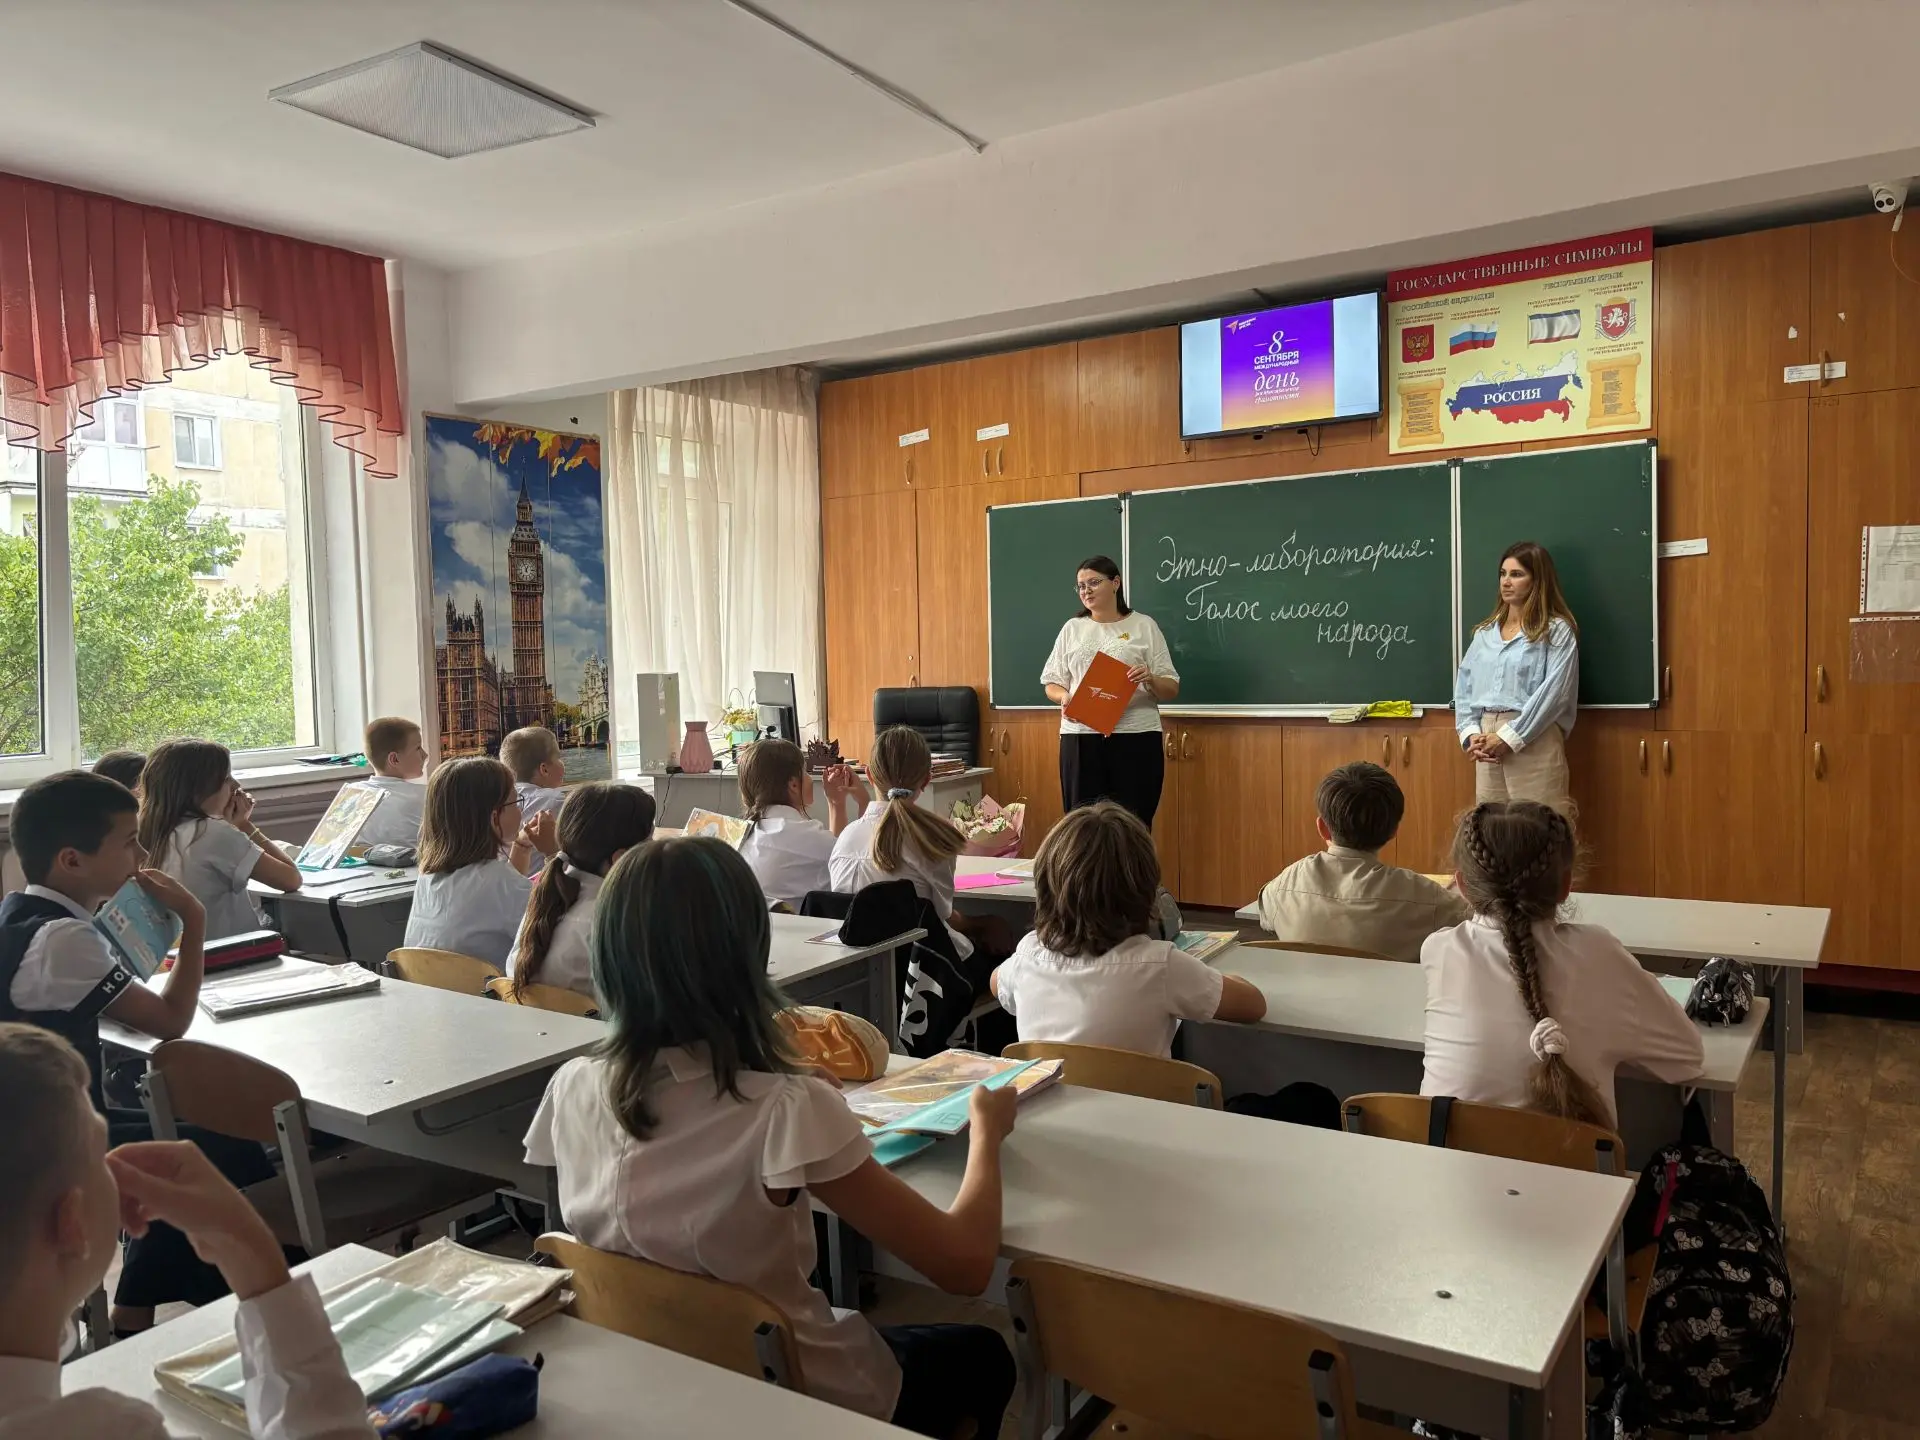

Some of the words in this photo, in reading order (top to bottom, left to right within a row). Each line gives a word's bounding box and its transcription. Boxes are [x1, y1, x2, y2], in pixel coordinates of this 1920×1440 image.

[1396, 255, 1550, 292] ГОСУДАРСТВЕННЫЕ
[1554, 240, 1643, 266] СИМВОЛЫ
[1268, 330, 1284, 355] 8
[1254, 350, 1299, 365] СЕНТЯБРЯ
[1254, 370, 1300, 391] день
[1483, 388, 1541, 405] РОССИЯ
[1186, 580, 1262, 621] Голос
[1270, 600, 1348, 622] моего
[1317, 620, 1415, 660] народа
